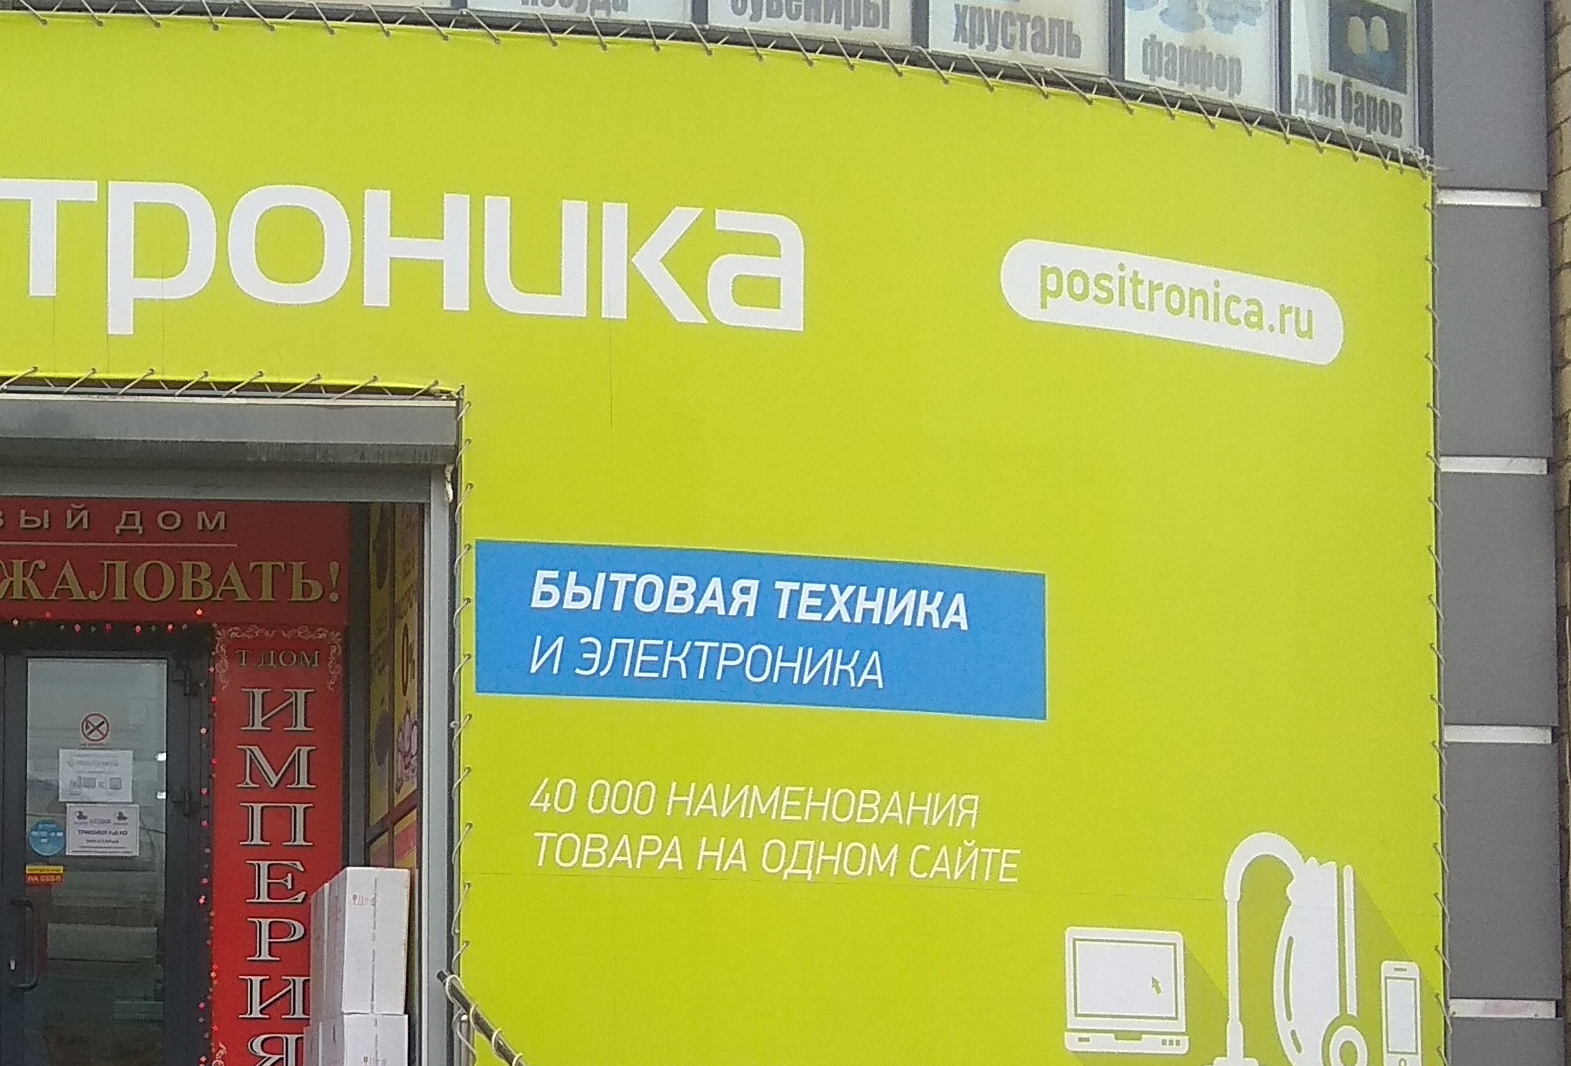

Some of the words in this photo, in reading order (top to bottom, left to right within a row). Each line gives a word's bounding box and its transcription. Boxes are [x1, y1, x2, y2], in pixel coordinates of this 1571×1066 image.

[953, 4, 1081, 58] хрусталь
[1142, 34, 1242, 97] фарфор
[1294, 74, 1336, 118] для
[1341, 80, 1402, 138] баров
[1039, 263, 1314, 340] positronica.ru
[531, 570, 759, 619] БЫТОВАЯ
[774, 580, 969, 631] ТЕХНИКА
[530, 636, 563, 675] И
[574, 637, 885, 689] ЭЛЕКТРОНИКА
[531, 777, 577, 813] 40
[587, 779, 657, 815] 000
[666, 781, 981, 828] НАИМЕНОВАНИЯ
[533, 832, 683, 870] ТОВАРА
[696, 836, 748, 872] НА
[760, 838, 898, 881] ОДНОМ
[908, 840, 1021, 883] САЙТЕ
